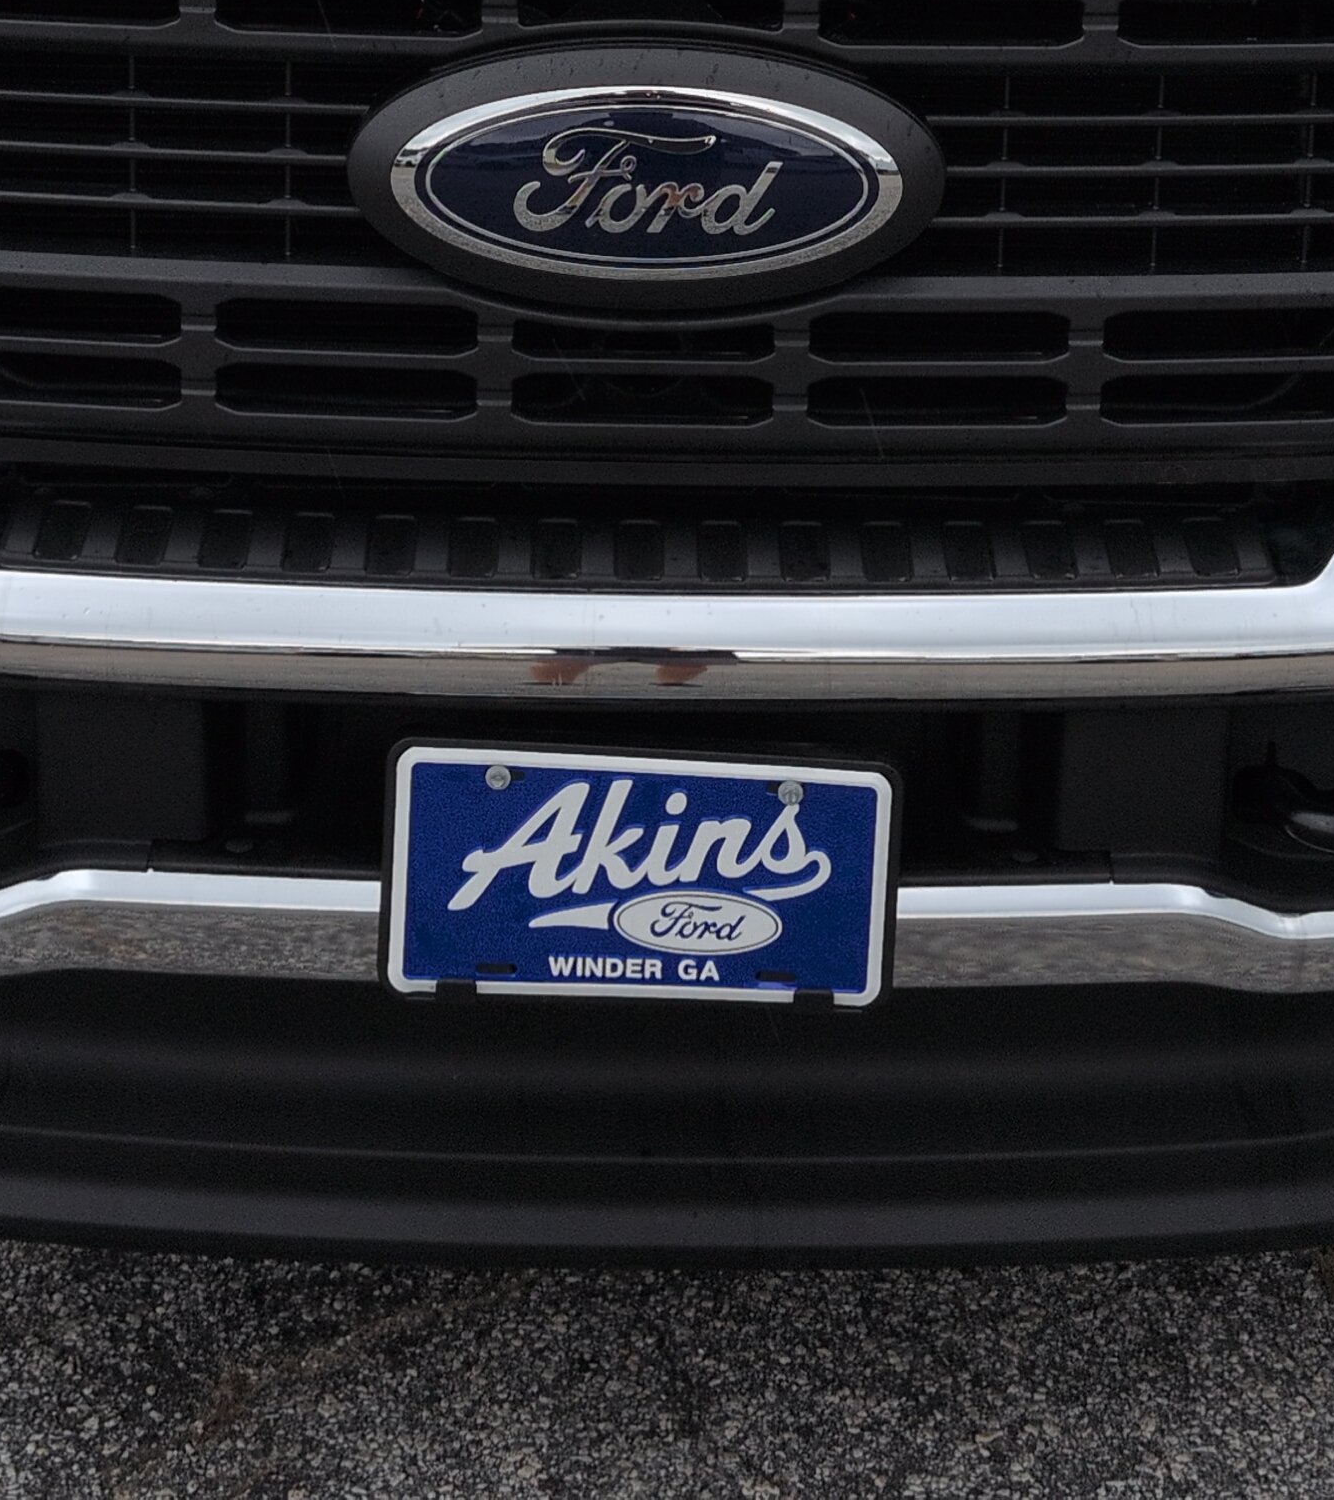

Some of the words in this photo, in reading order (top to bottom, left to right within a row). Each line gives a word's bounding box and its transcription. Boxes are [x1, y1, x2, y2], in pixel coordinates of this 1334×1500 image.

[513, 126, 783, 236] Ford
[447, 779, 831, 911] Akins
[650, 902, 746, 942] Ford
[548, 956, 662, 980] WINDER
[677, 960, 720, 982] GA
